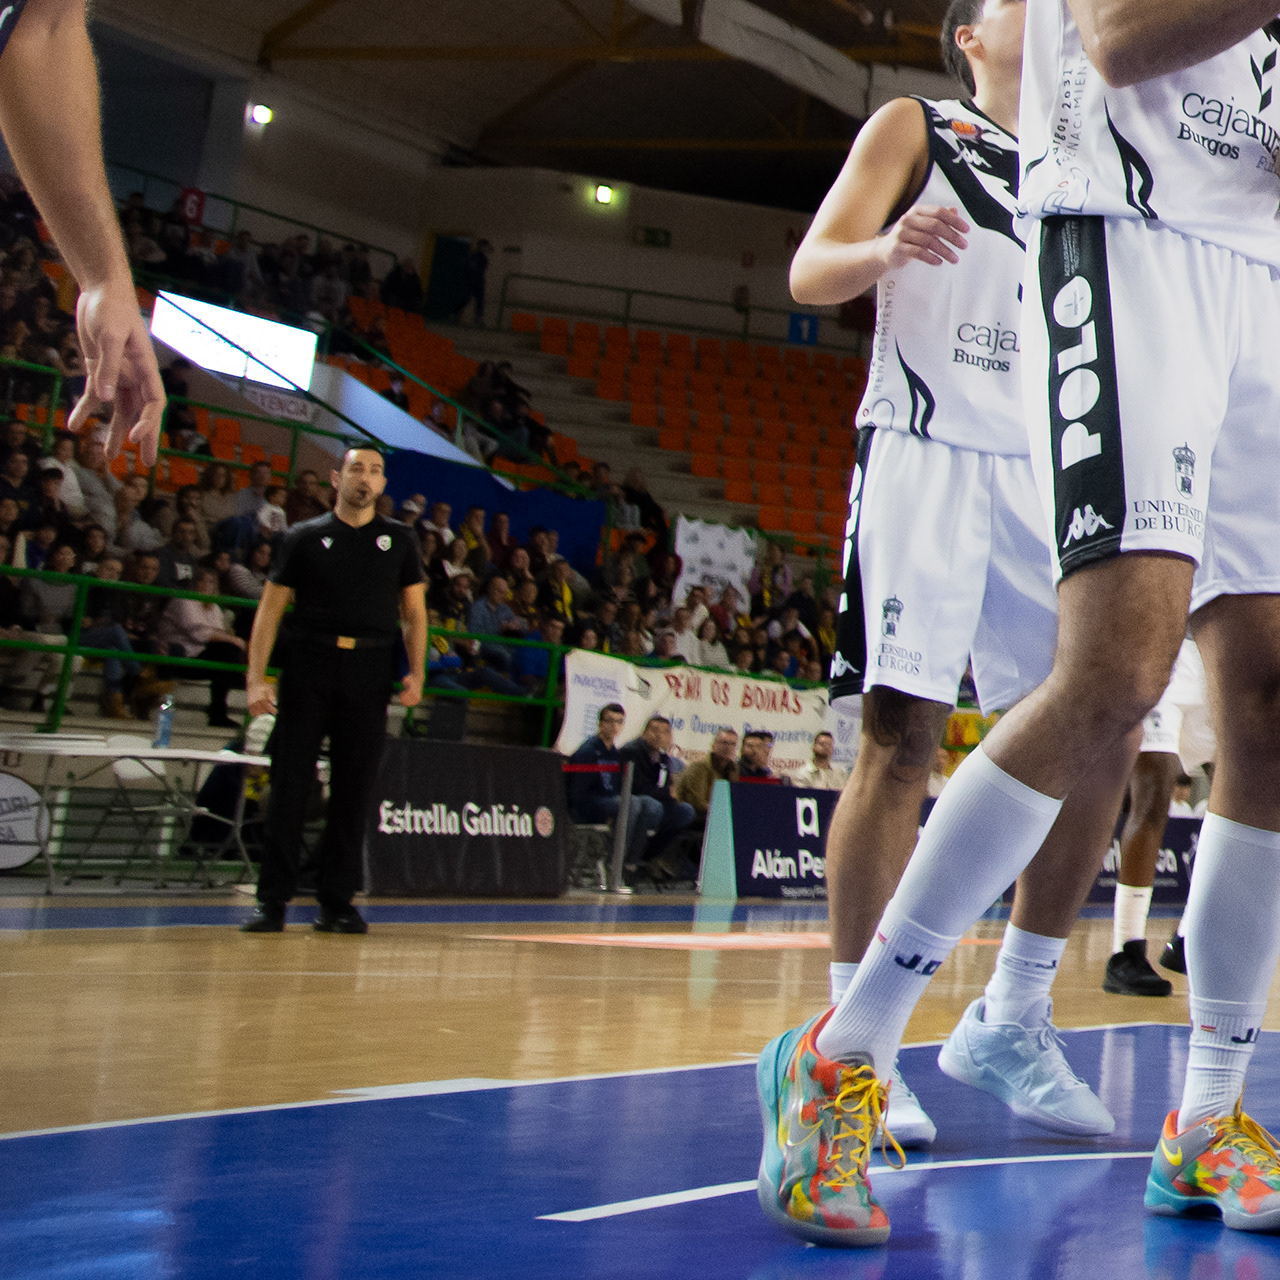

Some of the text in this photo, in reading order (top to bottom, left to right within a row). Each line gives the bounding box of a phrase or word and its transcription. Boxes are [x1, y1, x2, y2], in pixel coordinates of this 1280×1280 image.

[1177, 122, 1240, 160] Burgos
[953, 348, 1011, 372] Burgos
[1053, 275, 1102, 470] POLO
[1135, 515, 1206, 540] DE BURG
[378, 800, 534, 837] Estrella Galicia
[751, 849, 797, 879] Alán
